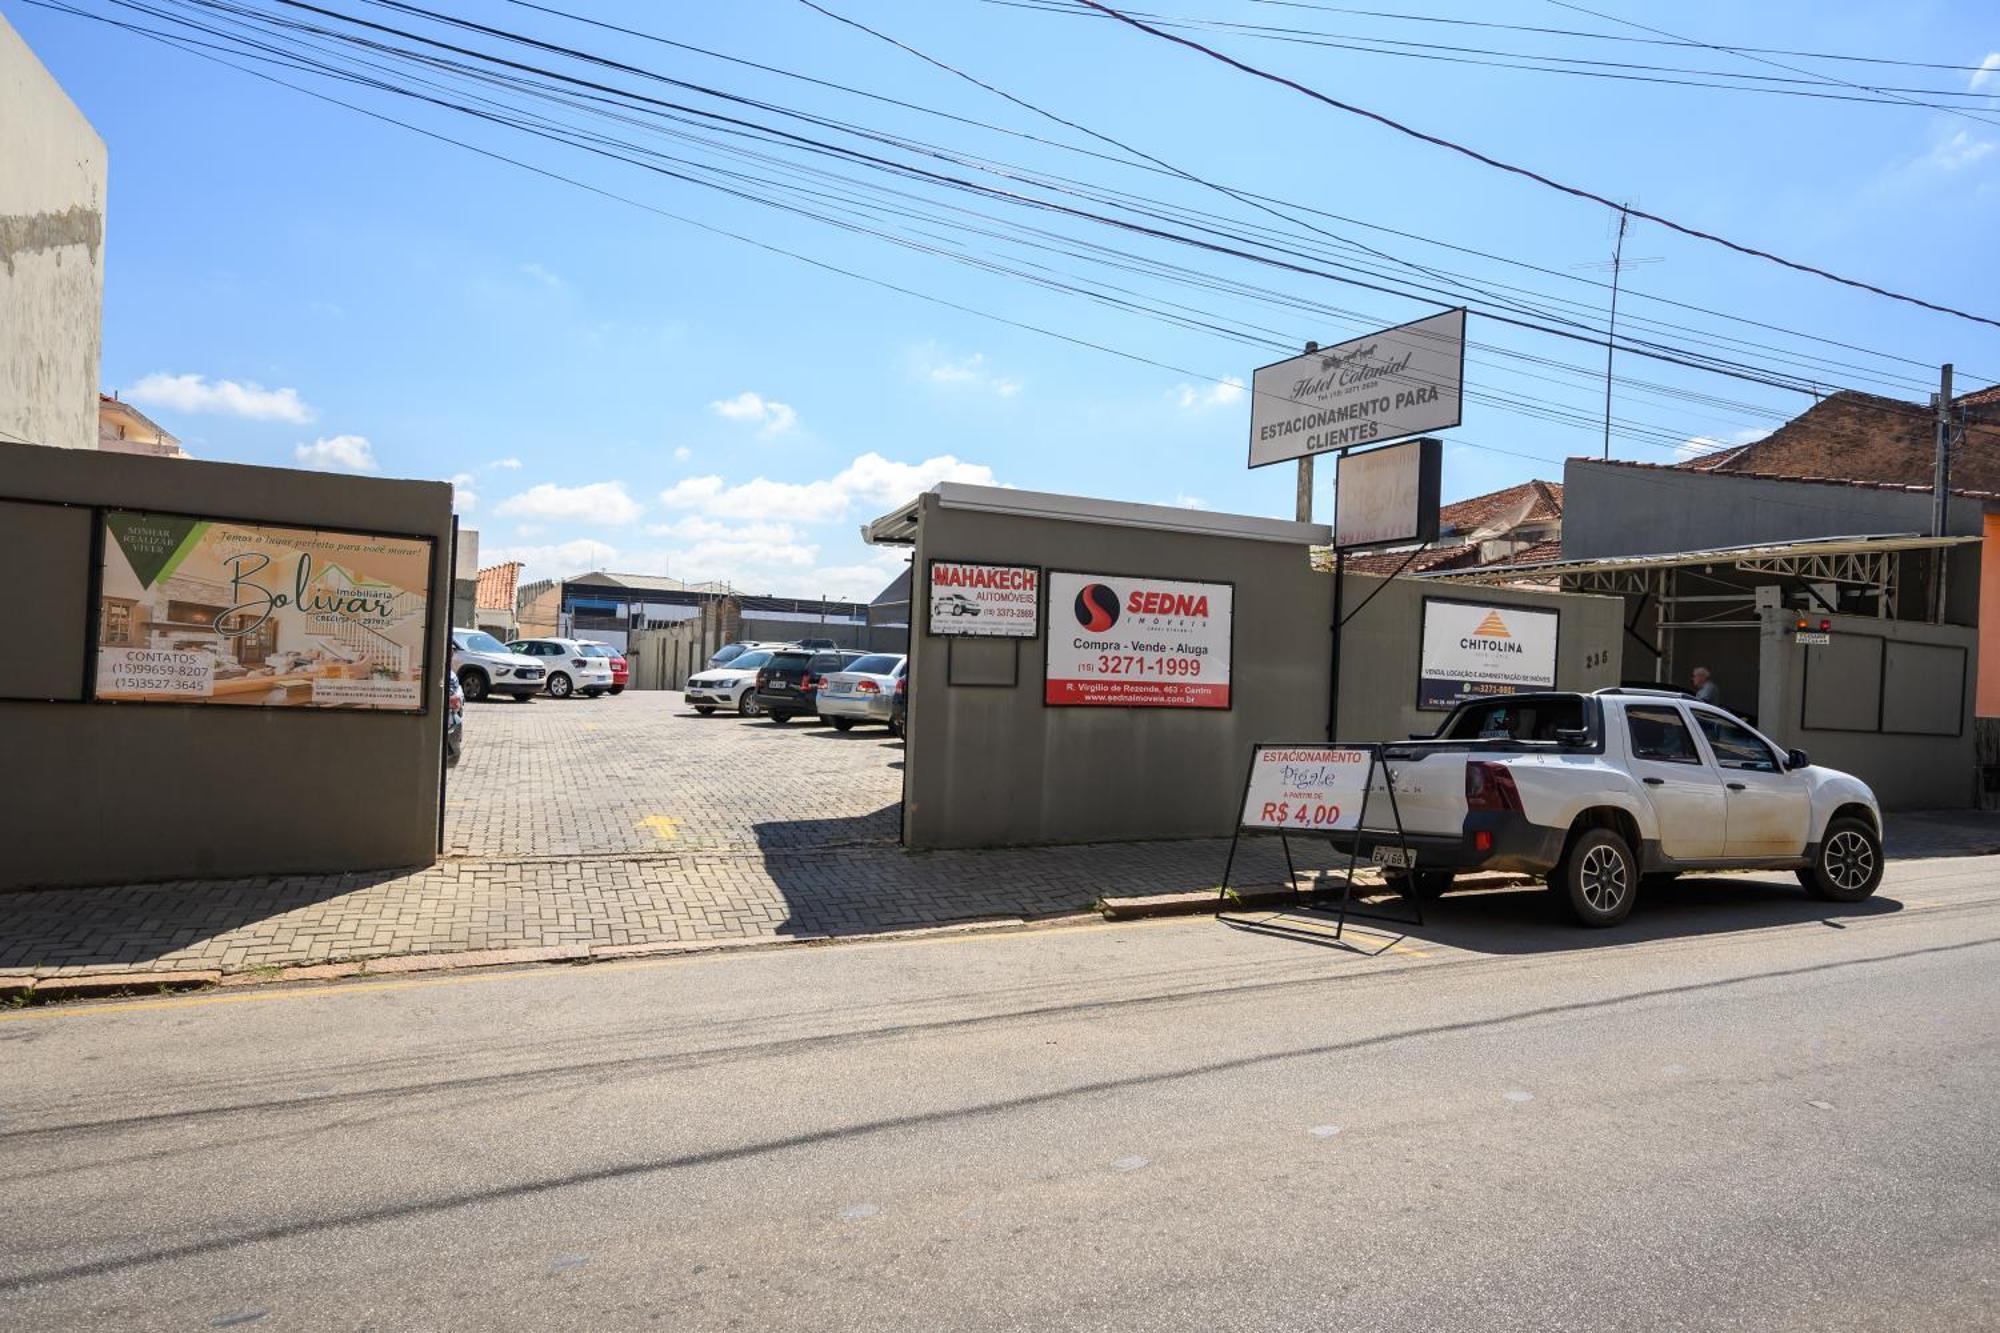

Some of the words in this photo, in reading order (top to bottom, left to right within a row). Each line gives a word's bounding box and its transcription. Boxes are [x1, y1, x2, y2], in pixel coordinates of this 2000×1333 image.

[1291, 372, 1336, 399] Hotel
[1339, 351, 1412, 386] Colonial
[1260, 396, 1390, 441] ESTACIONAMENTO
[1395, 385, 1439, 410] PARA
[1306, 421, 1379, 450] CLIENTES
[934, 566, 1034, 591] MAHAKECH
[213, 552, 395, 636] Bolivar
[1126, 591, 1209, 618] SEDNA
[1073, 638, 1121, 653] Compra
[1131, 641, 1167, 653] Vende
[1176, 643, 1209, 657] Aluga
[1460, 638, 1522, 653] CHITOLINA
[112, 663, 209, 677] (15)99659-8207
[1078, 663, 1094, 673] (15)
[1098, 655, 1201, 676] 3271-1999
[115, 677, 204, 691] (15)3527-3645
[1110, 684, 1122, 692] de
[1263, 751, 1362, 763] ESTACIONAMENTO
[1280, 764, 1336, 789] Pigale
[1261, 801, 1289, 824] R$
[1294, 803, 1340, 827] 4,00
